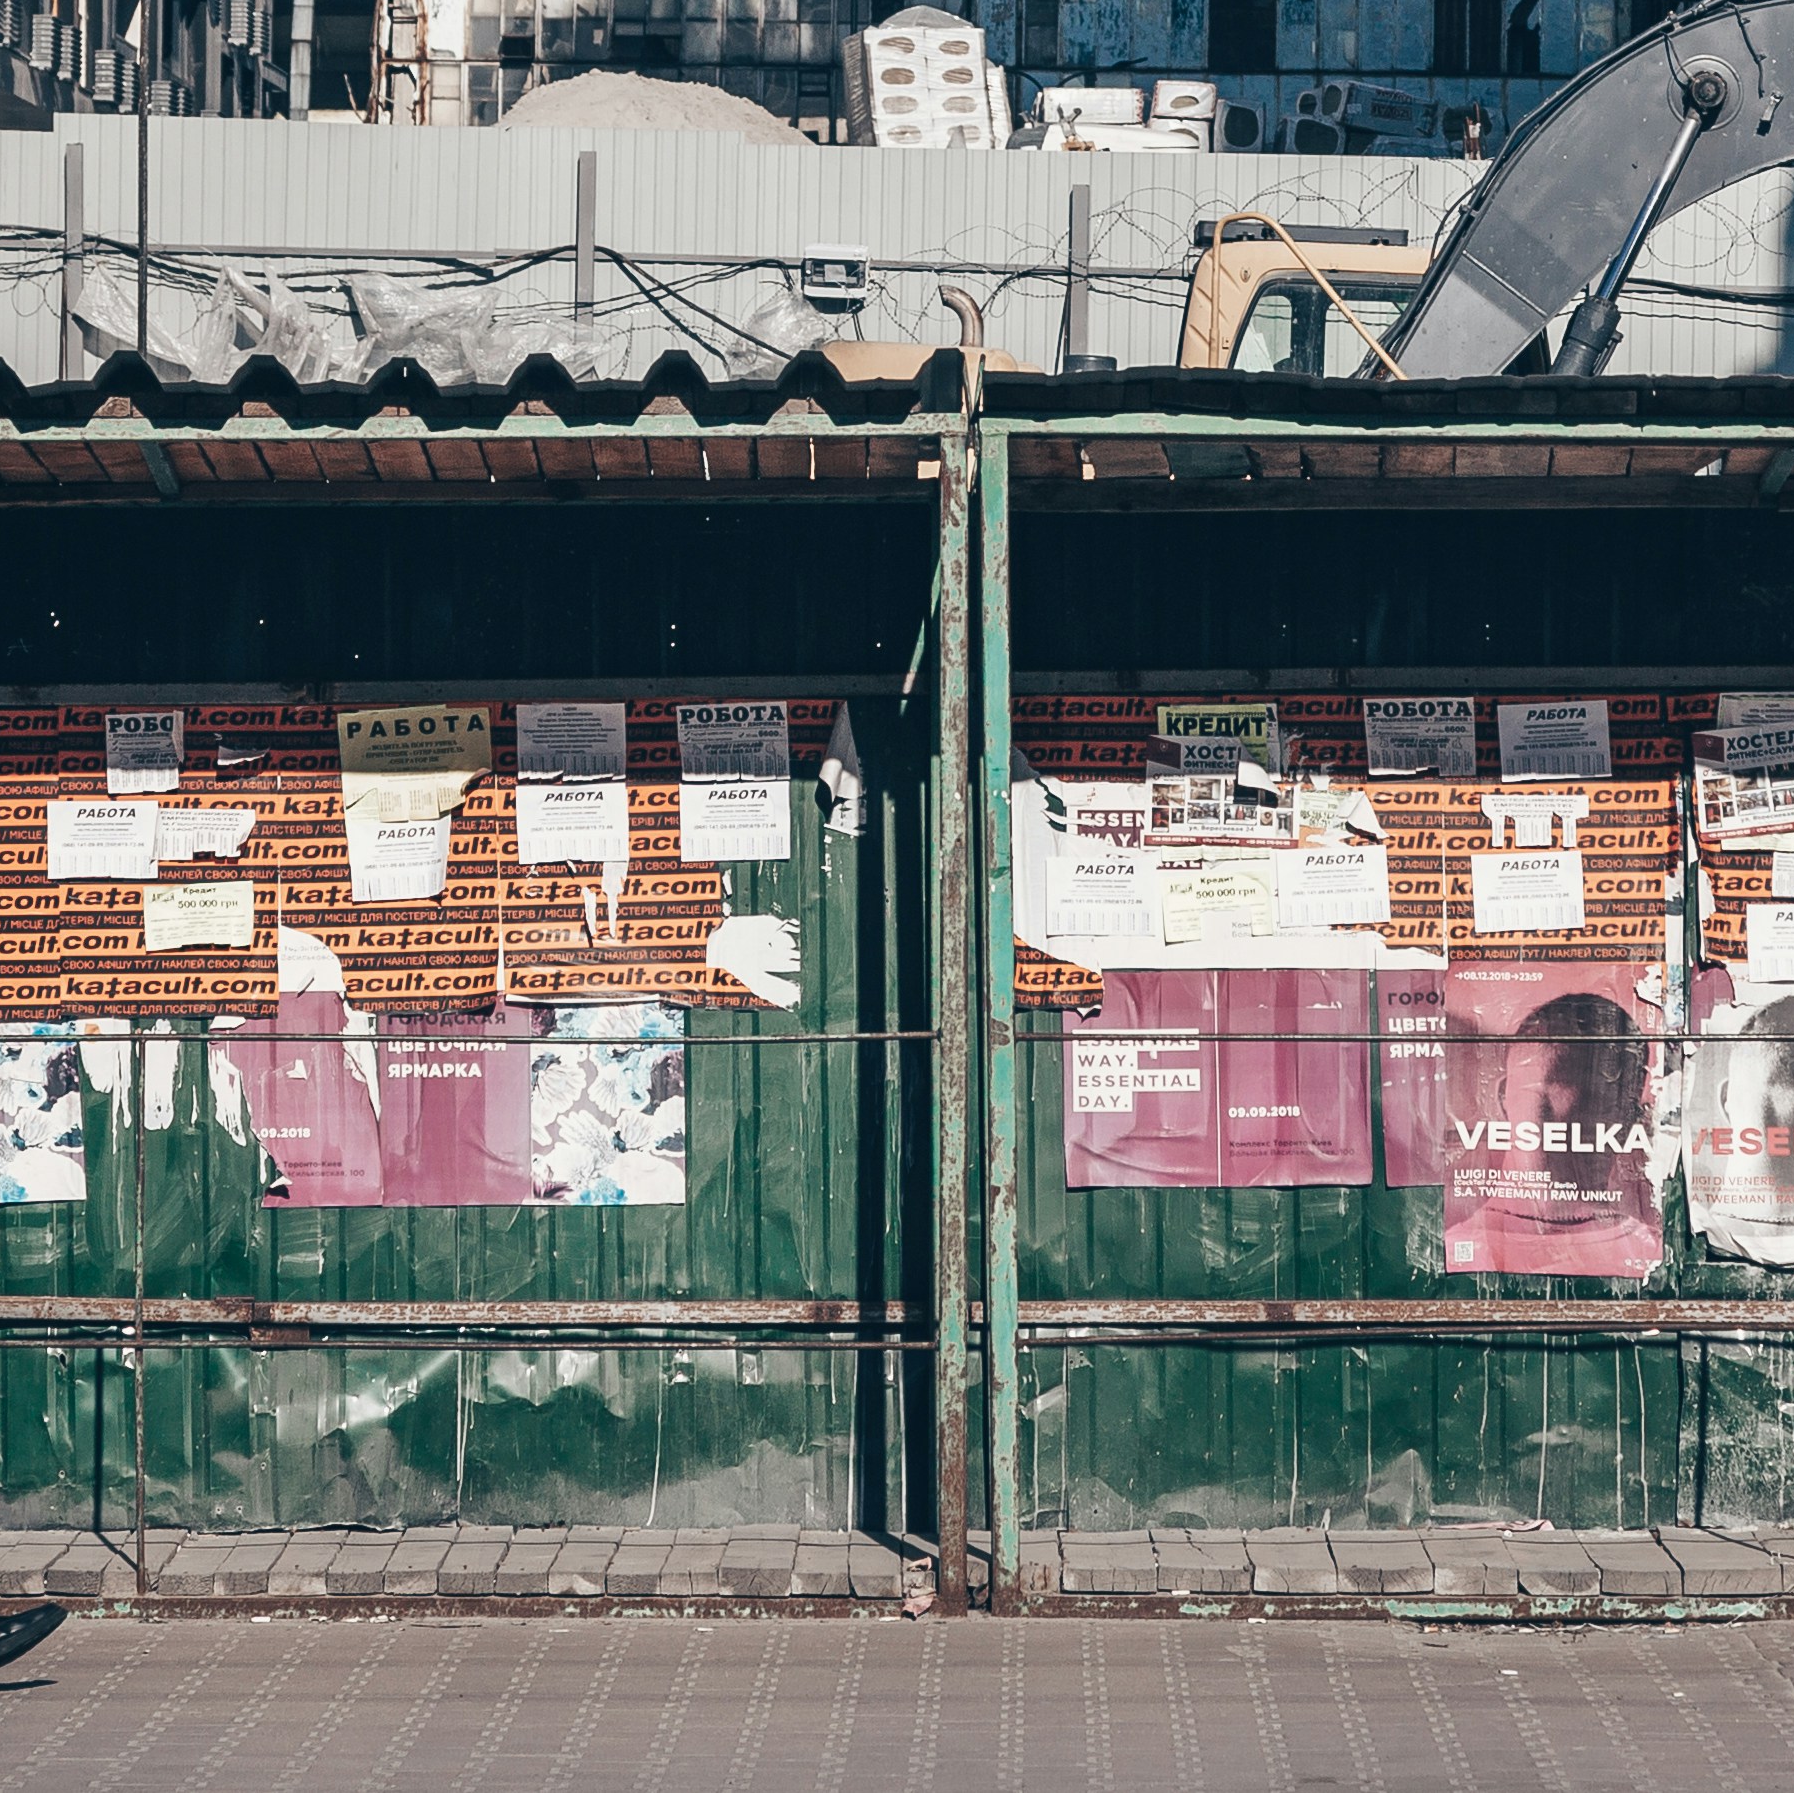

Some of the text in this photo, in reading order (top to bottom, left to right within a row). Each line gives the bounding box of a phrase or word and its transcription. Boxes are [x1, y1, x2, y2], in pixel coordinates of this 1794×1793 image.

[680, 705, 786, 725] РОБОТА
[1367, 701, 1472, 717] РОБОТА
[1527, 708, 1587, 721] РАБОТА
[347, 714, 485, 739] РАБОТА
[1165, 718, 1266, 737] КРЕДИТ
[544, 791, 604, 802] РАБОТА
[708, 789, 768, 800] РАБОТА
[77, 808, 137, 819] РАБОТА
[377, 826, 436, 840] РАБОТА
[1305, 854, 1365, 866] РАБОТА
[1501, 859, 1561, 872] РАБОТА
[1075, 865, 1135, 876] РАБОТА
[1195, 890, 1215, 899] 500
[1217, 889, 1236, 898] 000
[178, 899, 199, 908] 500
[201, 899, 218, 908] 000
[62, 959, 276, 970] СВОЮ АФІШУ ТУТ НАКЛЕЙ СВОЮ АФІШУ
[1079, 1055, 1133, 1067] WAY.
[388, 1063, 482, 1078] ЯРМАРКА
[1079, 1074, 1196, 1088] ESSENTIAL
[1078, 1095, 1128, 1108] DAY.
[1228, 1106, 1300, 1119] 09.09.2018
[1455, 1120, 1654, 1154] VESELKA
[1454, 1169, 1551, 1182] LUIGI DI VENERE
[1729, 1176, 1775, 1186] VENERE
[1454, 1187, 1623, 1202] S.A. TWEEMAN RAW UNKUT
[1706, 1193, 1766, 1204] TWEEMAN
